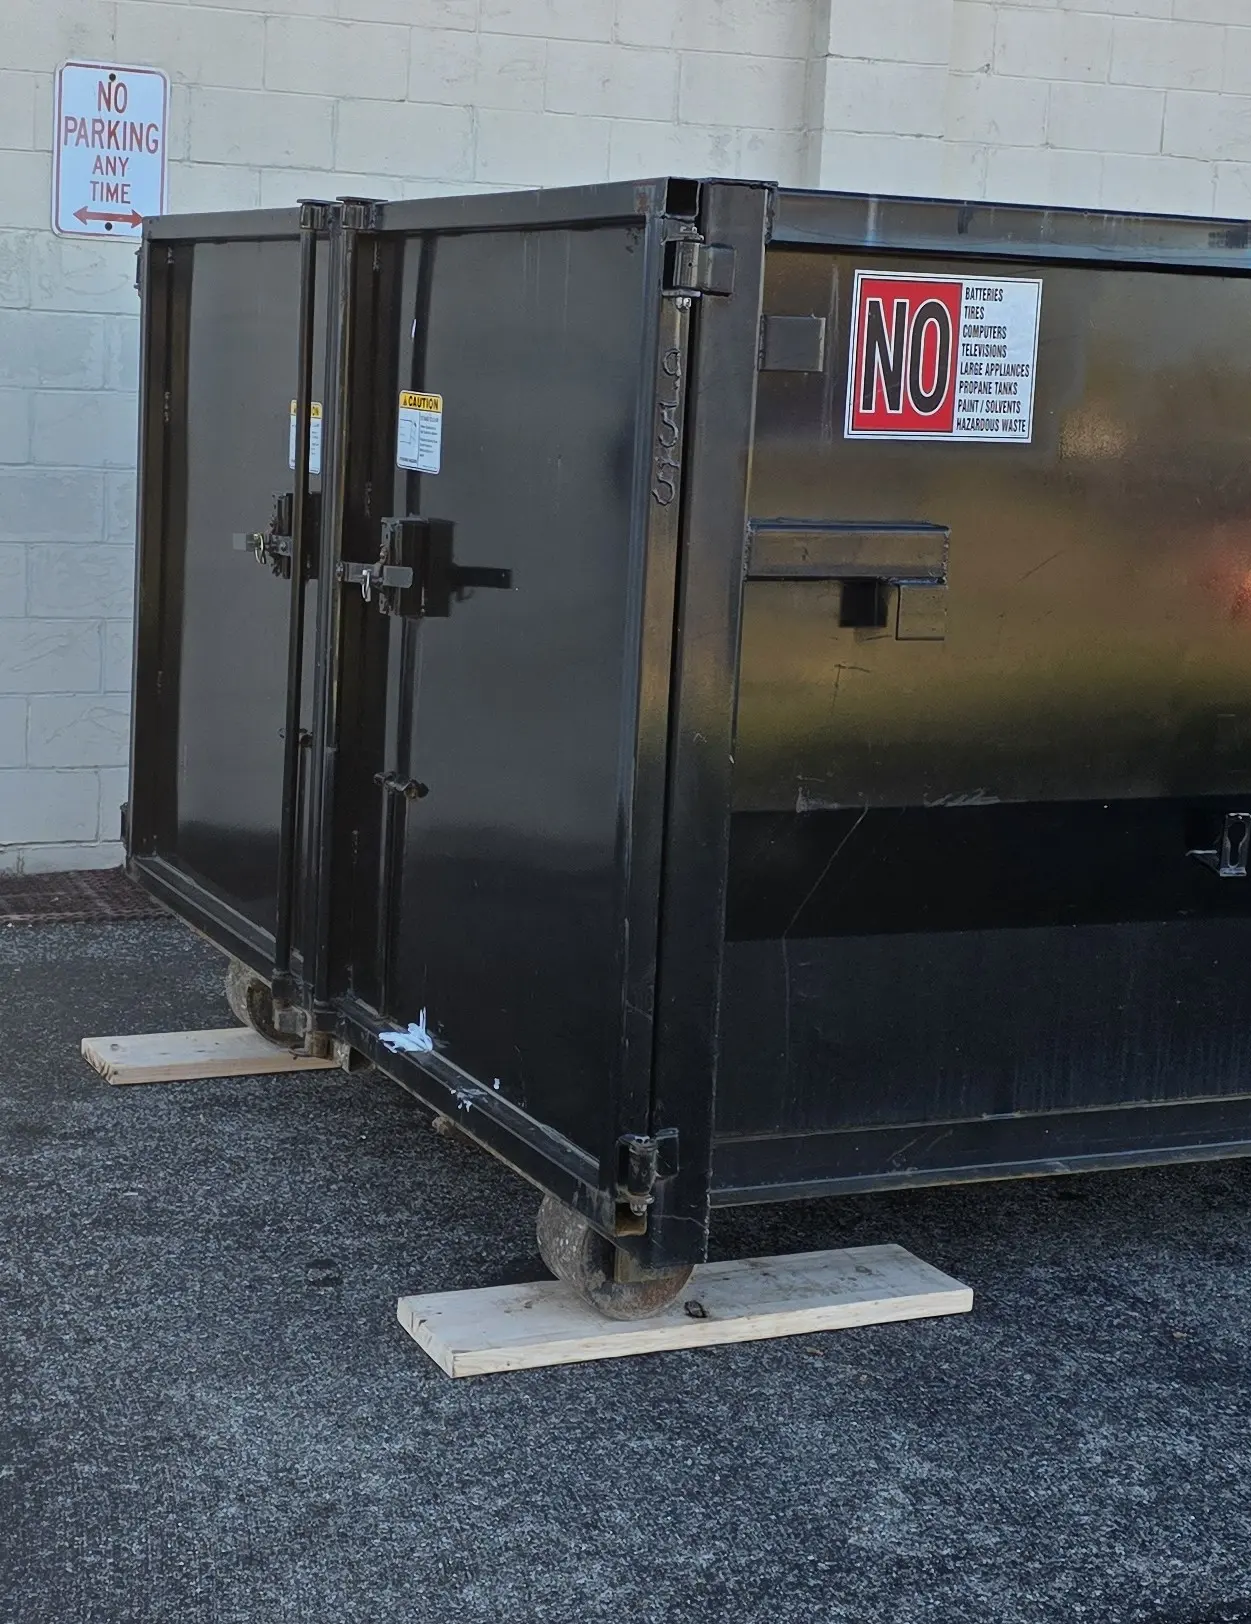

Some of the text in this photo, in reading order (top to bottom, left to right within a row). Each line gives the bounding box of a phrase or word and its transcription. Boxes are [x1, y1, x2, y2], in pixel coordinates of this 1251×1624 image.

[97, 80, 128, 114] NO
[63, 115, 159, 154] PARKING
[92, 154, 129, 177] ANY
[89, 180, 131, 204] TIME
[965, 287, 1004, 302] BATTERIES
[964, 305, 985, 320] TIRES
[962, 324, 1007, 340] COMPUTERS
[859, 297, 953, 416] NO
[961, 343, 1007, 359] TELEVISIONS
[960, 362, 1030, 378] LARGE APPLIANCES
[958, 380, 1018, 396] PROPANE TANKS
[408, 395, 439, 411] CAUTION
[957, 399, 979, 413] PAINT
[985, 400, 1021, 415] SOLVENTS
[956, 417, 1026, 433] HAZARDOUS WASTE
